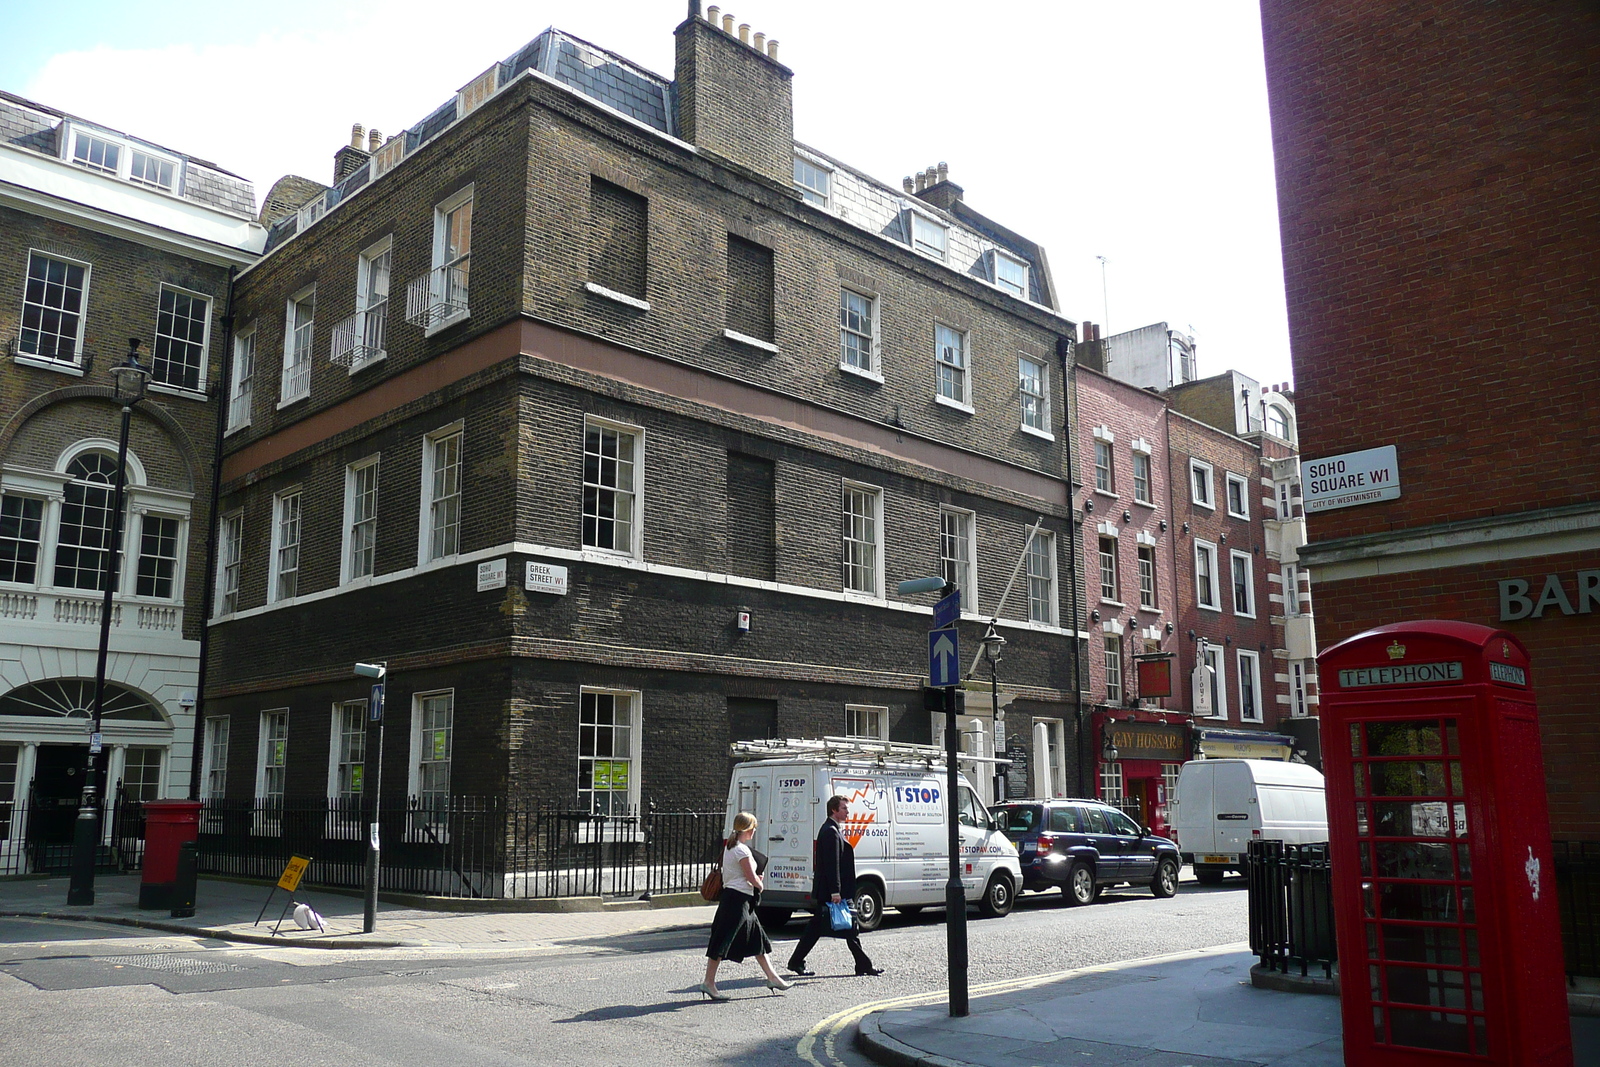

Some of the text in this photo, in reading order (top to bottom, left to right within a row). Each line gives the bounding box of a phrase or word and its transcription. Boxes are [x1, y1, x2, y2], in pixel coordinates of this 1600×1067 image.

[1309, 460, 1346, 478] SOHO
[1311, 468, 1390, 494] SQUARE W1
[1336, 491, 1382, 504] WESTMINSTER
[480, 564, 491, 574] SOHO
[480, 571, 496, 581] SQUARE
[530, 564, 551, 575] GREEK
[530, 573, 564, 585] STREET W1
[1498, 569, 1600, 622] BAR
[1342, 663, 1458, 685] TELEPHONE
[1490, 662, 1525, 684] TELEPHONE
[1113, 731, 1177, 750] GAY HUSSAR
[905, 787, 940, 803] STOP
